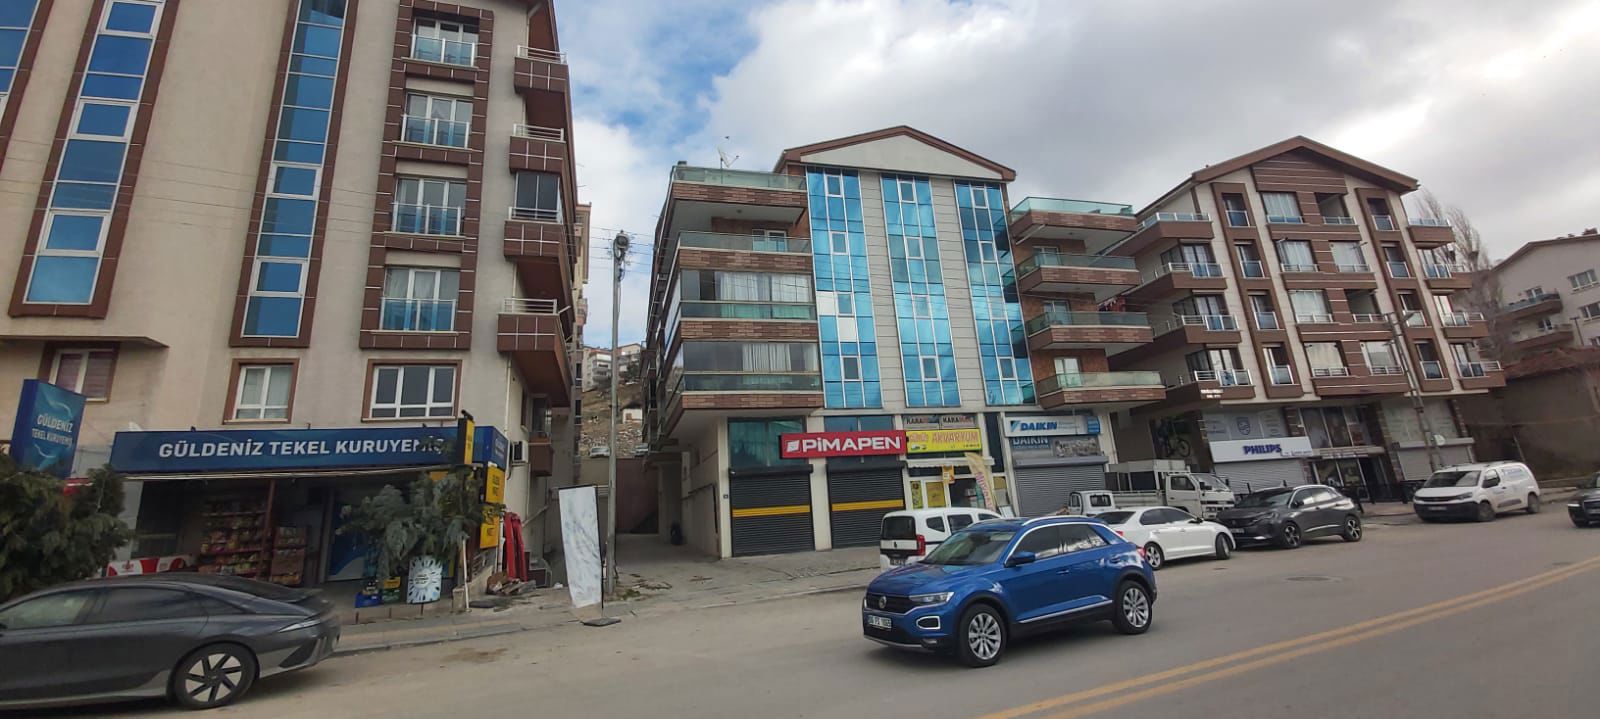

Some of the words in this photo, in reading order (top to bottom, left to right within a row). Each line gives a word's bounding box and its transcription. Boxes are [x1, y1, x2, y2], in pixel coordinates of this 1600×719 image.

[1021, 421, 1057, 431] DAIKIN
[159, 439, 264, 458] GÜLDENİZ
[269, 441, 330, 455] TEKEL
[1243, 444, 1282, 455] PHILIPS
